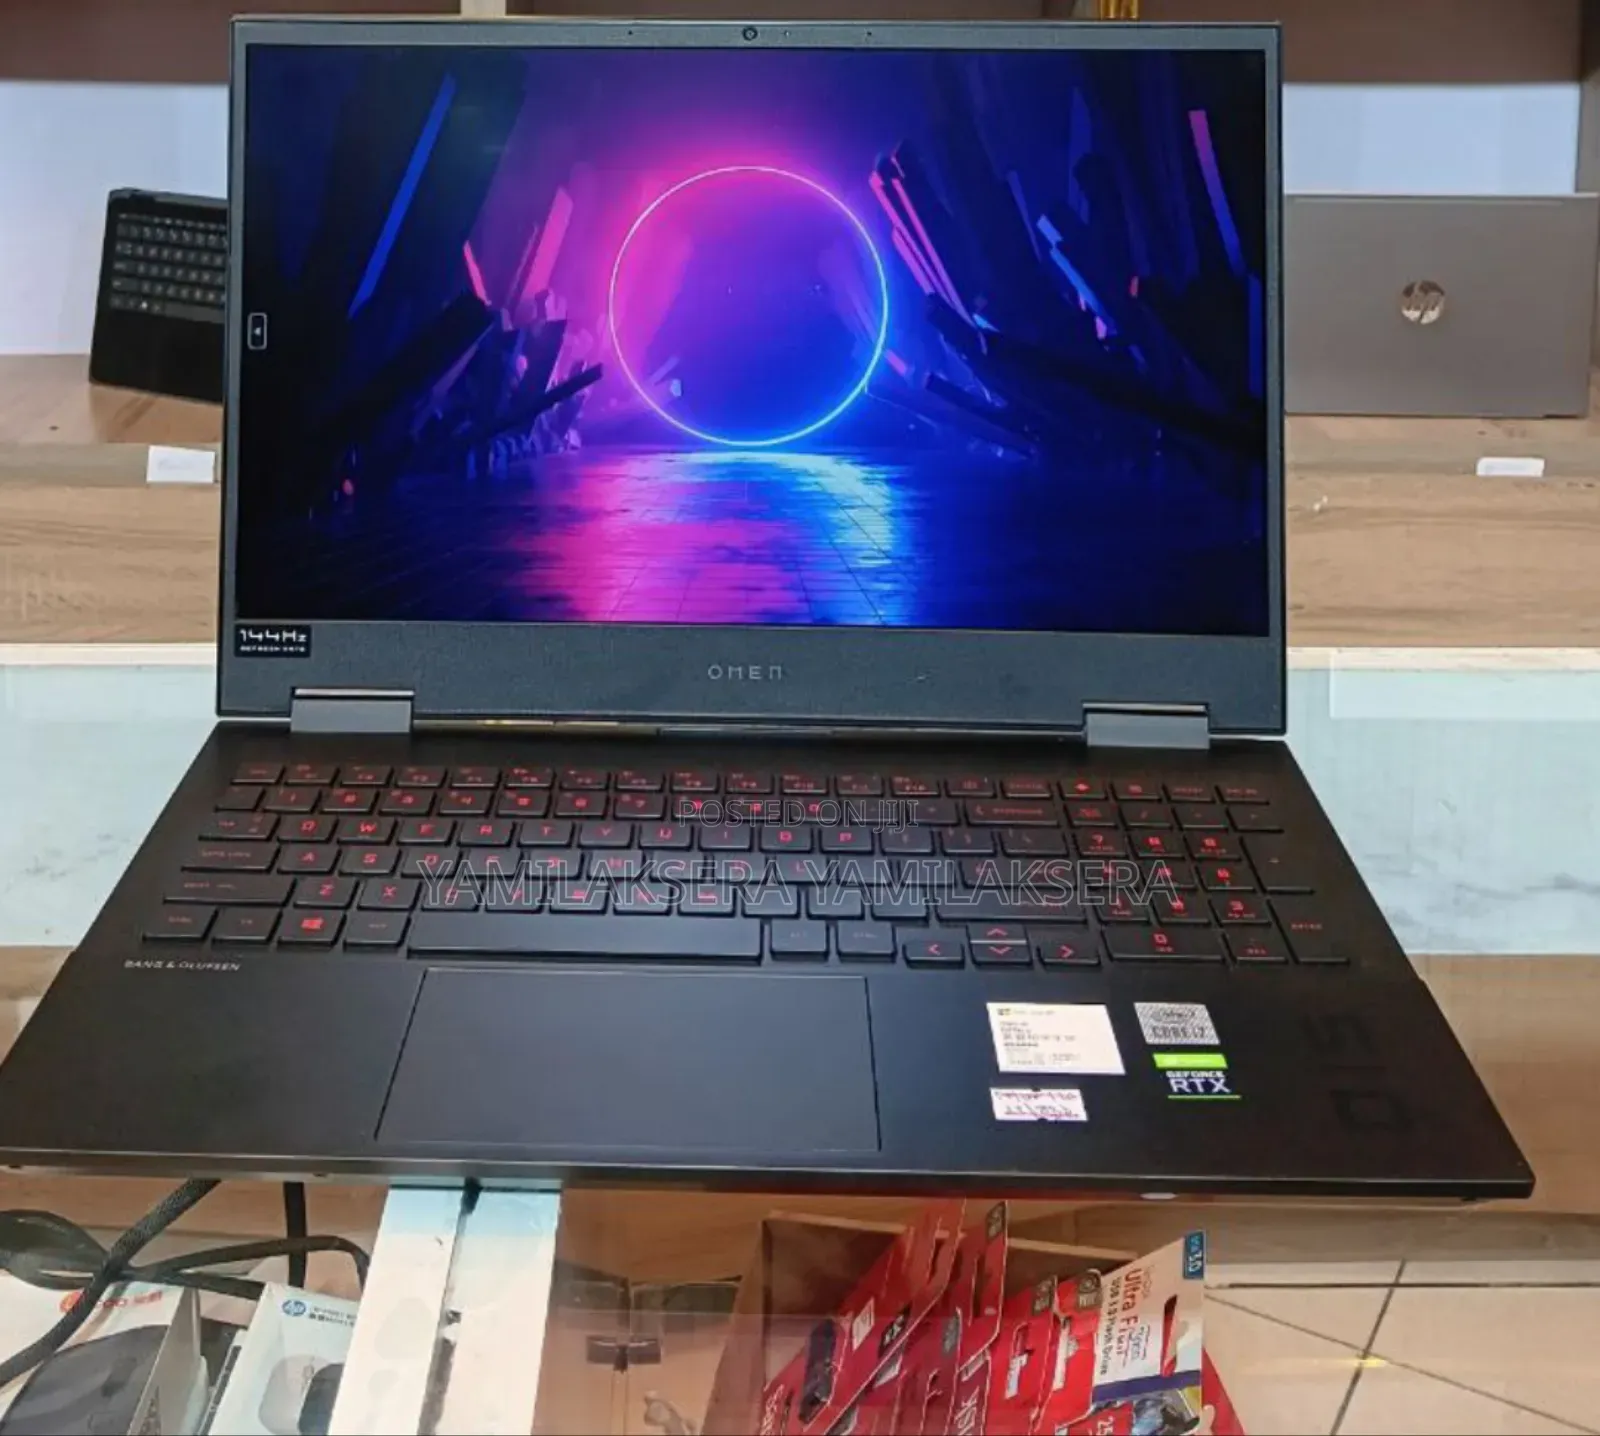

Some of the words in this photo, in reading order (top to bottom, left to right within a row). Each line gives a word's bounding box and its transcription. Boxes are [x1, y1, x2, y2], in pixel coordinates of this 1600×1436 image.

[239, 629, 307, 642] 144Hz
[707, 664, 782, 680] OMEN
[1169, 1078, 1231, 1093] RTX
[1121, 1268, 1144, 1311] Ultra
